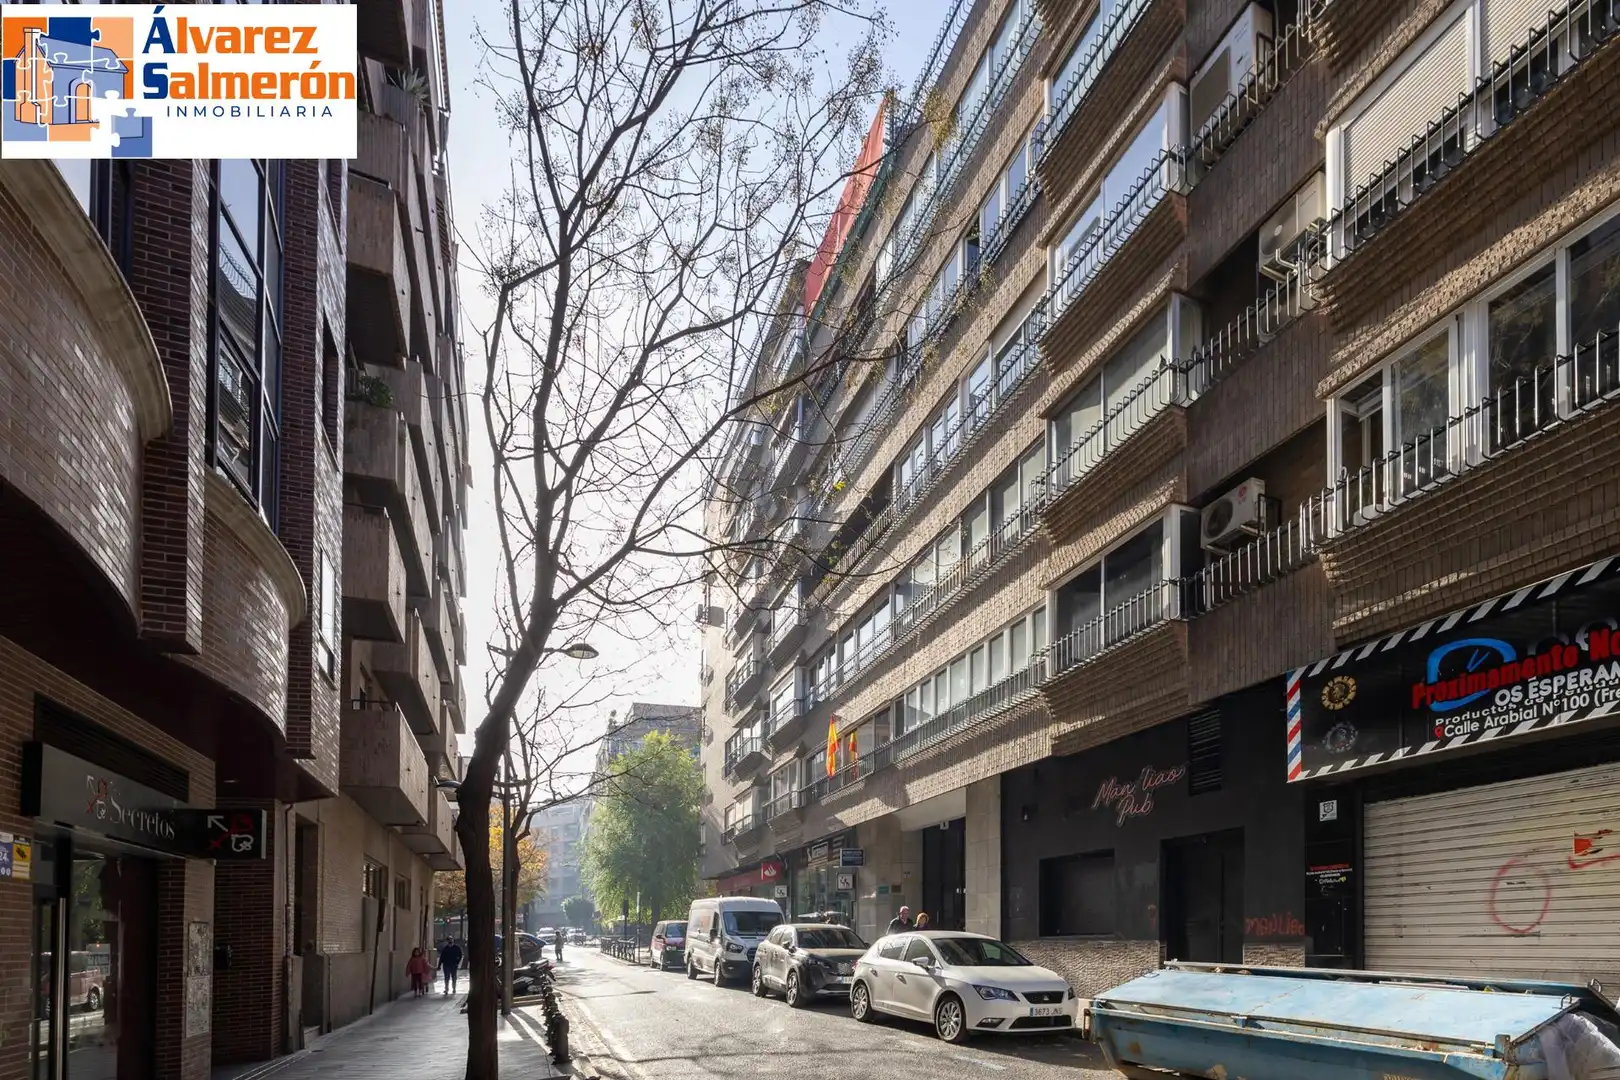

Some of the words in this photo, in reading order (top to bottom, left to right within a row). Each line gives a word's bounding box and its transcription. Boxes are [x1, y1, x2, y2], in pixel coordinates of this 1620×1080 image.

[1494, 685, 1523, 706] OS
[1444, 720, 1479, 737] Calle
[1484, 705, 1537, 729] Arabial
[110, 796, 175, 840] Secretos
[1116, 793, 1154, 827] Pub
